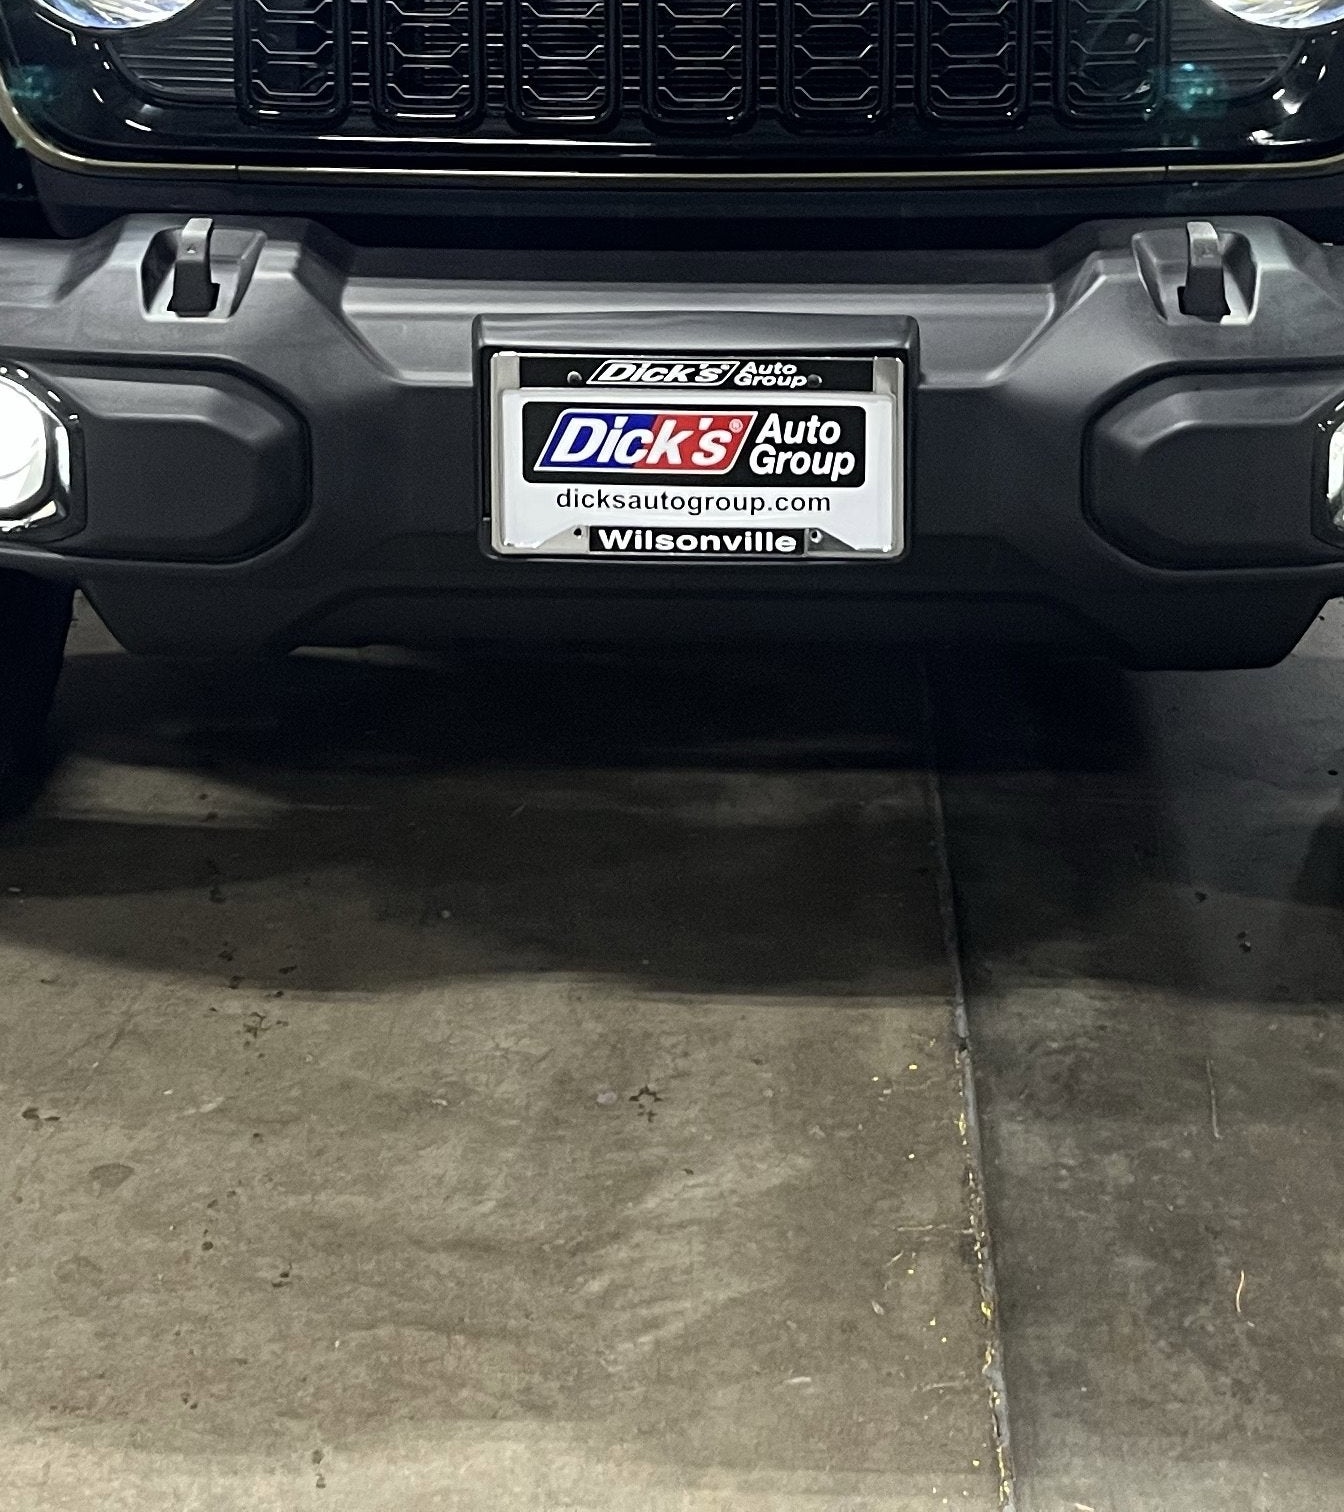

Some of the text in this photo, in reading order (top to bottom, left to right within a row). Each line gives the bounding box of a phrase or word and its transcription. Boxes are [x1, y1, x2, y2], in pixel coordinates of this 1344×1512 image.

[598, 361, 798, 384] Dick's Auto
[733, 373, 808, 389] Group
[550, 413, 842, 465] Dick's Auto
[748, 444, 856, 482] Group
[556, 488, 832, 516] dicksautogroup.com
[597, 528, 798, 553] Wilsonville
